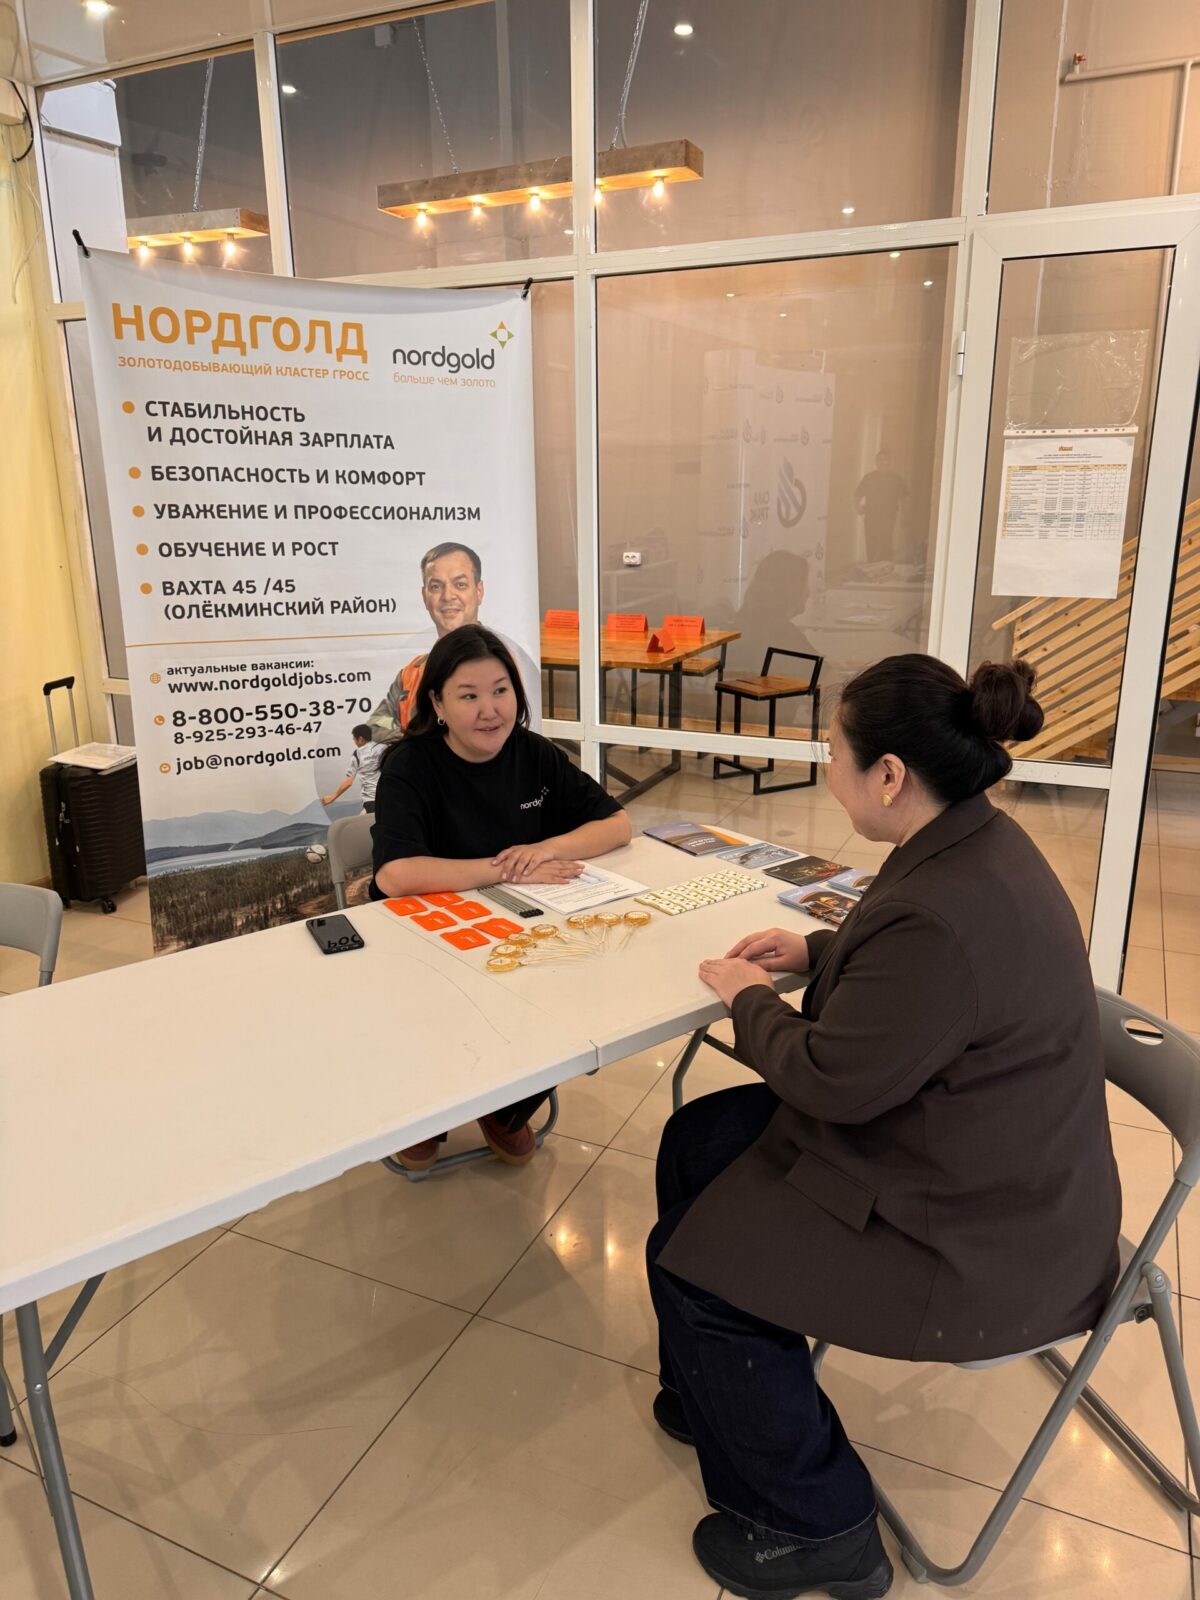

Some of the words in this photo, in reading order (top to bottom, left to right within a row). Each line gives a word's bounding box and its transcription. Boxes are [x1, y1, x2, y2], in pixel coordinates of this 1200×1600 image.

[111, 303, 368, 363] НОРДГОЛД
[117, 356, 272, 376] ЗОЛОТОДОБЫВАЮЩИЙ
[276, 367, 328, 379] КЛАСТЕР
[333, 369, 369, 381] ГРОСС
[393, 346, 494, 373] nordgold
[393, 371, 434, 385] больше
[437, 377, 458, 386] чем
[460, 377, 496, 388] золото
[145, 401, 305, 422] СТАБИЛЬНОСТЬ
[148, 427, 162, 442] И
[170, 426, 292, 446] ДОСТОЙНАЯ
[300, 432, 394, 449] ЗАРПЛАТА
[151, 466, 309, 483] БЕЗОПАСНОСТЬ
[316, 469, 328, 483] И
[336, 470, 425, 485] КОМФОРТ
[154, 504, 268, 519] УВАЖЕНИЕ
[275, 505, 287, 519] И
[294, 505, 480, 520] ПРОФЕССИОНАЛИЗМ
[159, 542, 266, 557] ОБУЧЕНИЕ
[272, 542, 285, 556] И
[292, 542, 338, 556] РОСТ
[162, 580, 226, 595] ВАХТА
[233, 580, 256, 594] 45
[165, 598, 324, 620] (ОЛЁКМИНСКИЙ
[331, 596, 396, 614] РАЙОН)
[167, 664, 247, 677] актуальные
[251, 659, 314, 671] вакансии:
[168, 669, 371, 693] www.nordgoldjobs.com
[172, 698, 372, 727] 8-800-550-38-70
[174, 721, 322, 744] 8-925-293-46-47
[176, 745, 341, 775] job@nordgold.com
